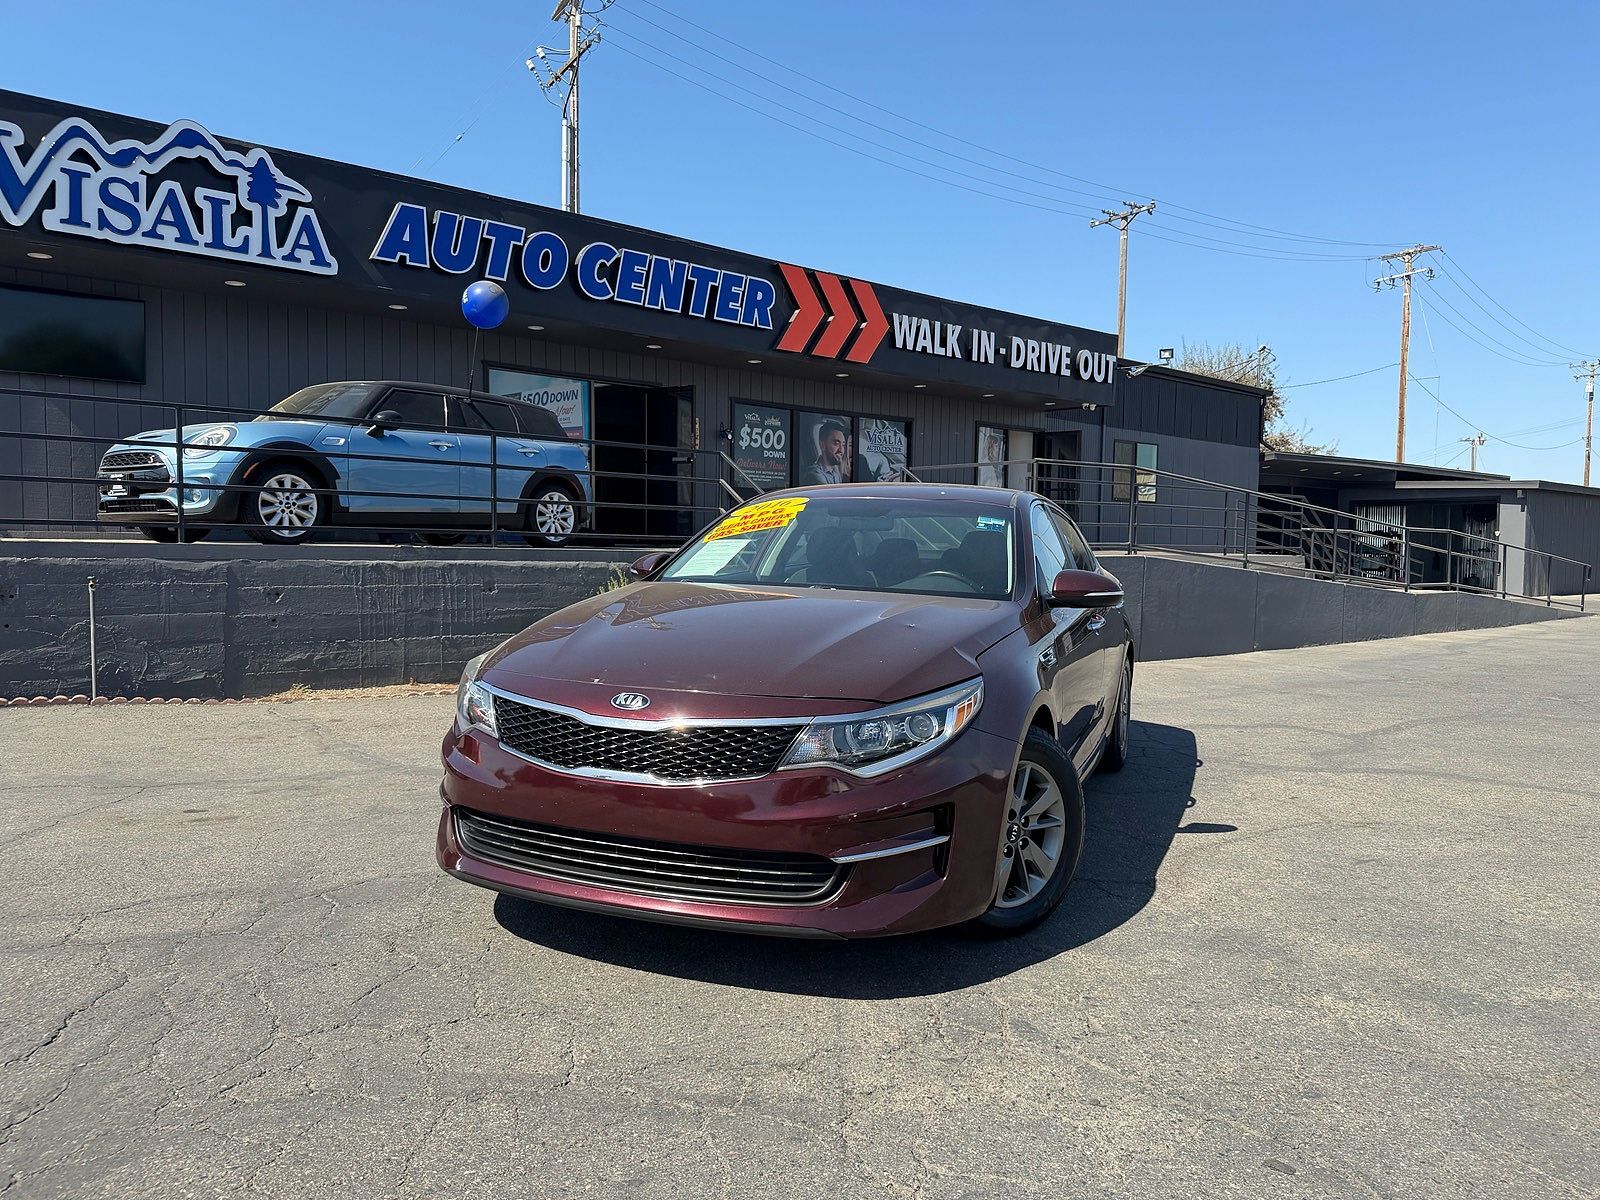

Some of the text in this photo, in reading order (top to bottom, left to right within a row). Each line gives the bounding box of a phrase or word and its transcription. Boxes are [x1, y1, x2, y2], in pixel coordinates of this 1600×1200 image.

[0, 118, 338, 276] VISALIA
[370, 202, 776, 329] AUTO CENTER
[892, 313, 962, 358] WALK
[971, 328, 995, 364] IN
[1010, 336, 1071, 376] DRIVE
[1077, 349, 1117, 384] OUT
[550, 389, 579, 403] DOWN
[738, 423, 786, 450] $500
[865, 424, 903, 446] VISALIA
[763, 450, 786, 459] DOWN
[1009, 825, 1019, 842] KIA
